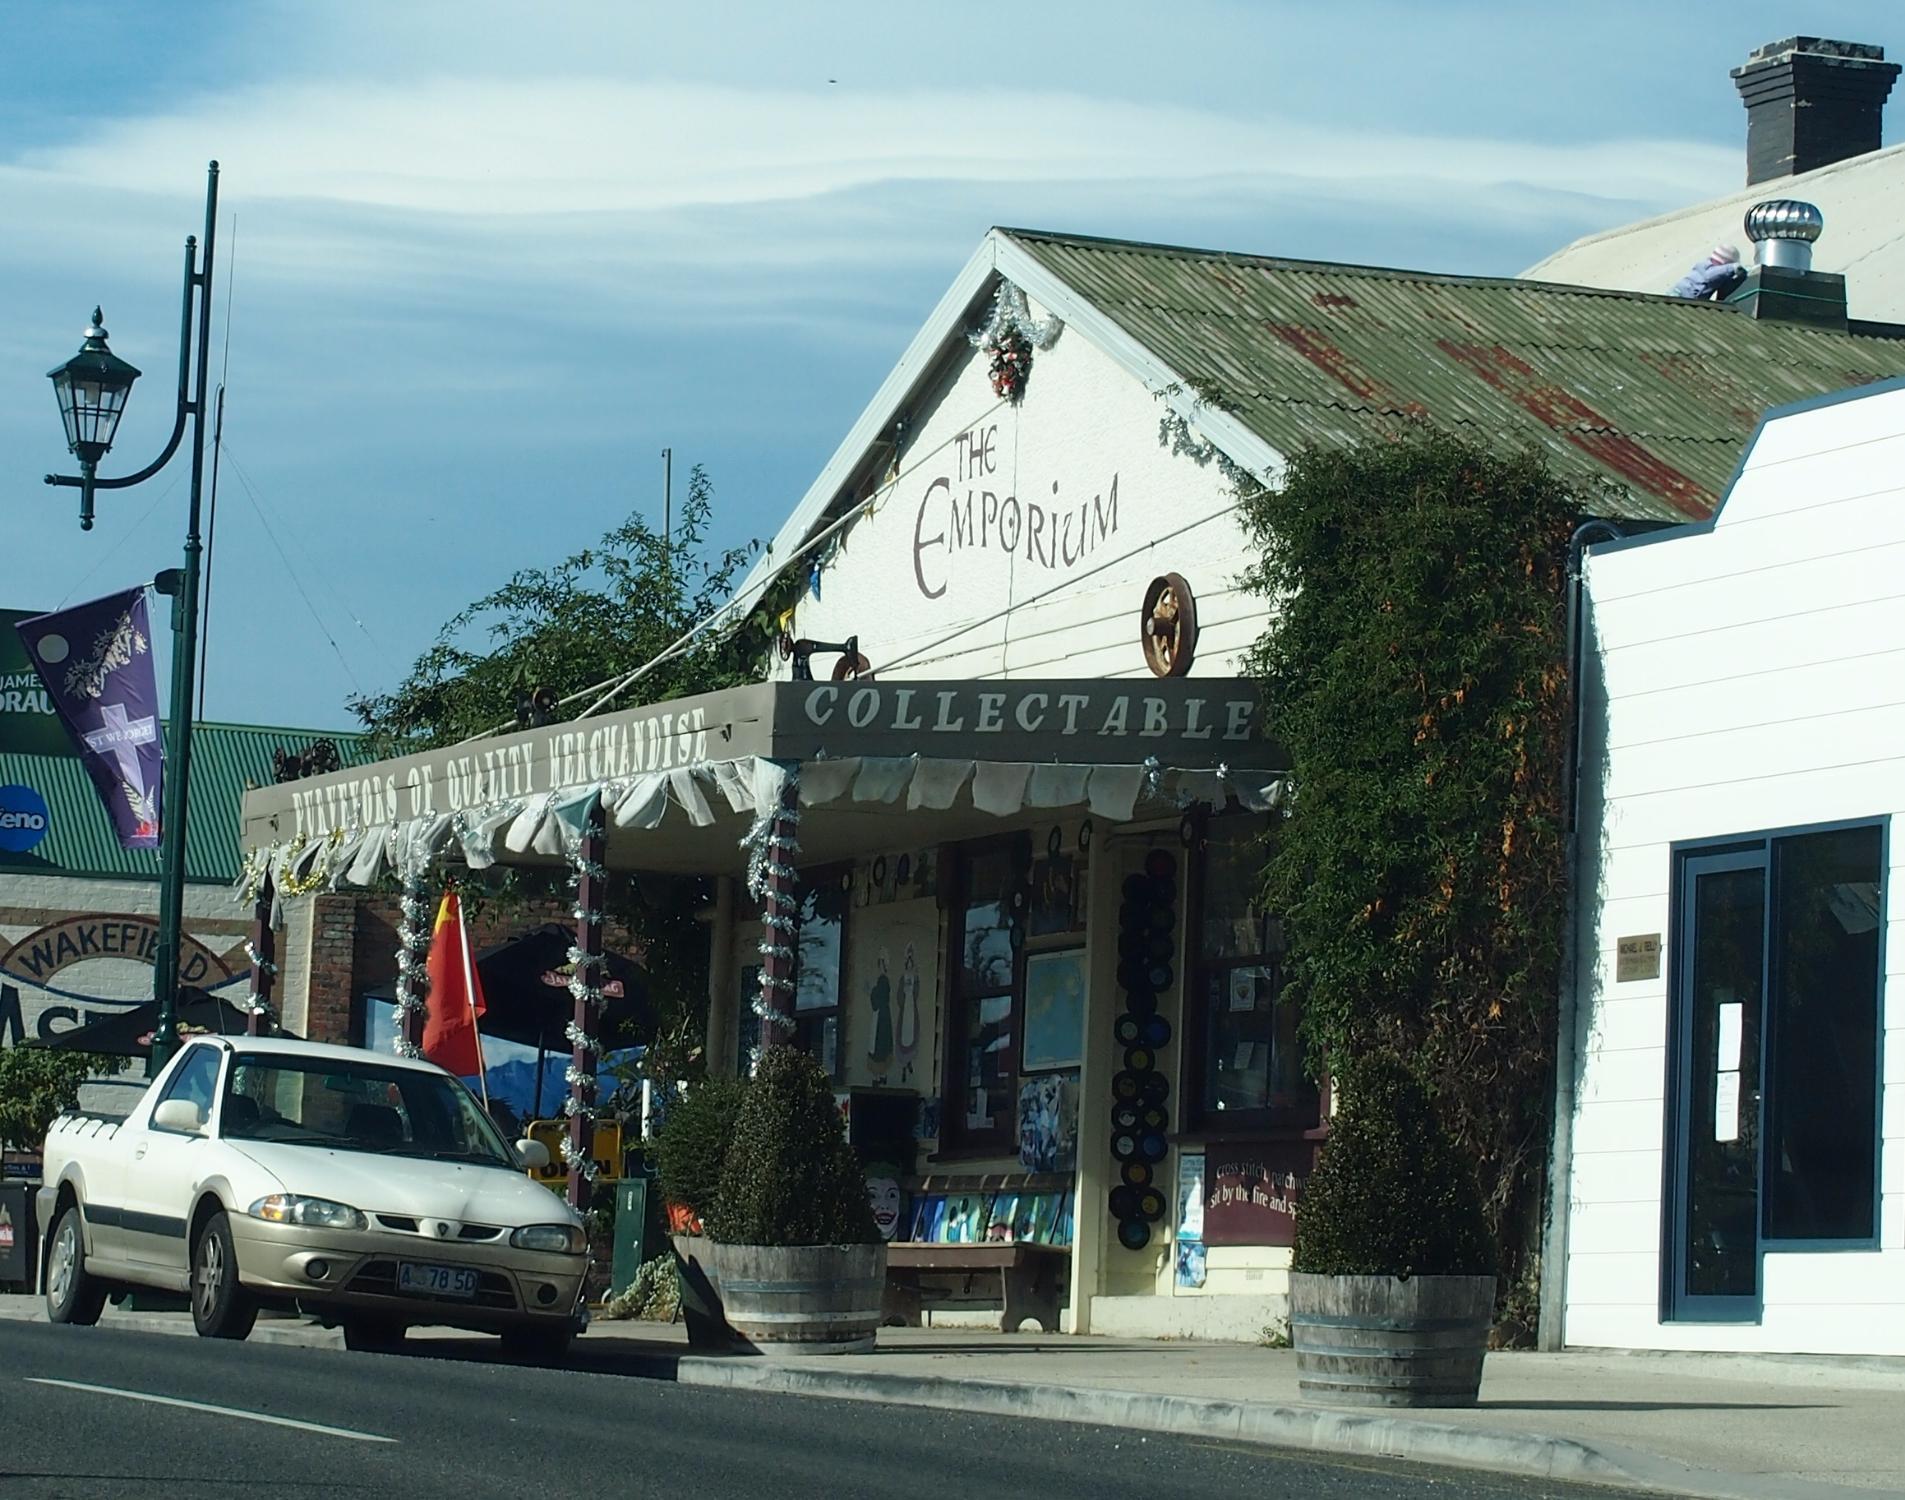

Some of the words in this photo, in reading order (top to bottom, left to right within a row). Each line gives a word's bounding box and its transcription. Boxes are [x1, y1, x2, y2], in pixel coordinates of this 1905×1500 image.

[954, 424, 998, 482] THE
[0, 674, 44, 691] JAME
[804, 686, 1255, 741] COLLECTABLE
[292, 773, 397, 839] PURVEYORS
[408, 765, 433, 816] OF
[447, 743, 533, 811] QUALITY
[549, 707, 708, 788] MERCHANDISE
[18, 923, 208, 982] WAKEFIED
[540, 1160, 611, 1178] OPN
[1216, 1161, 1239, 1179] cross
[1222, 1184, 1234, 1206] by
[1235, 1183, 1249, 1202] the
[1253, 1185, 1269, 1207] fire
[1269, 1195, 1287, 1213] and
[430, 1268, 449, 1289] 78
